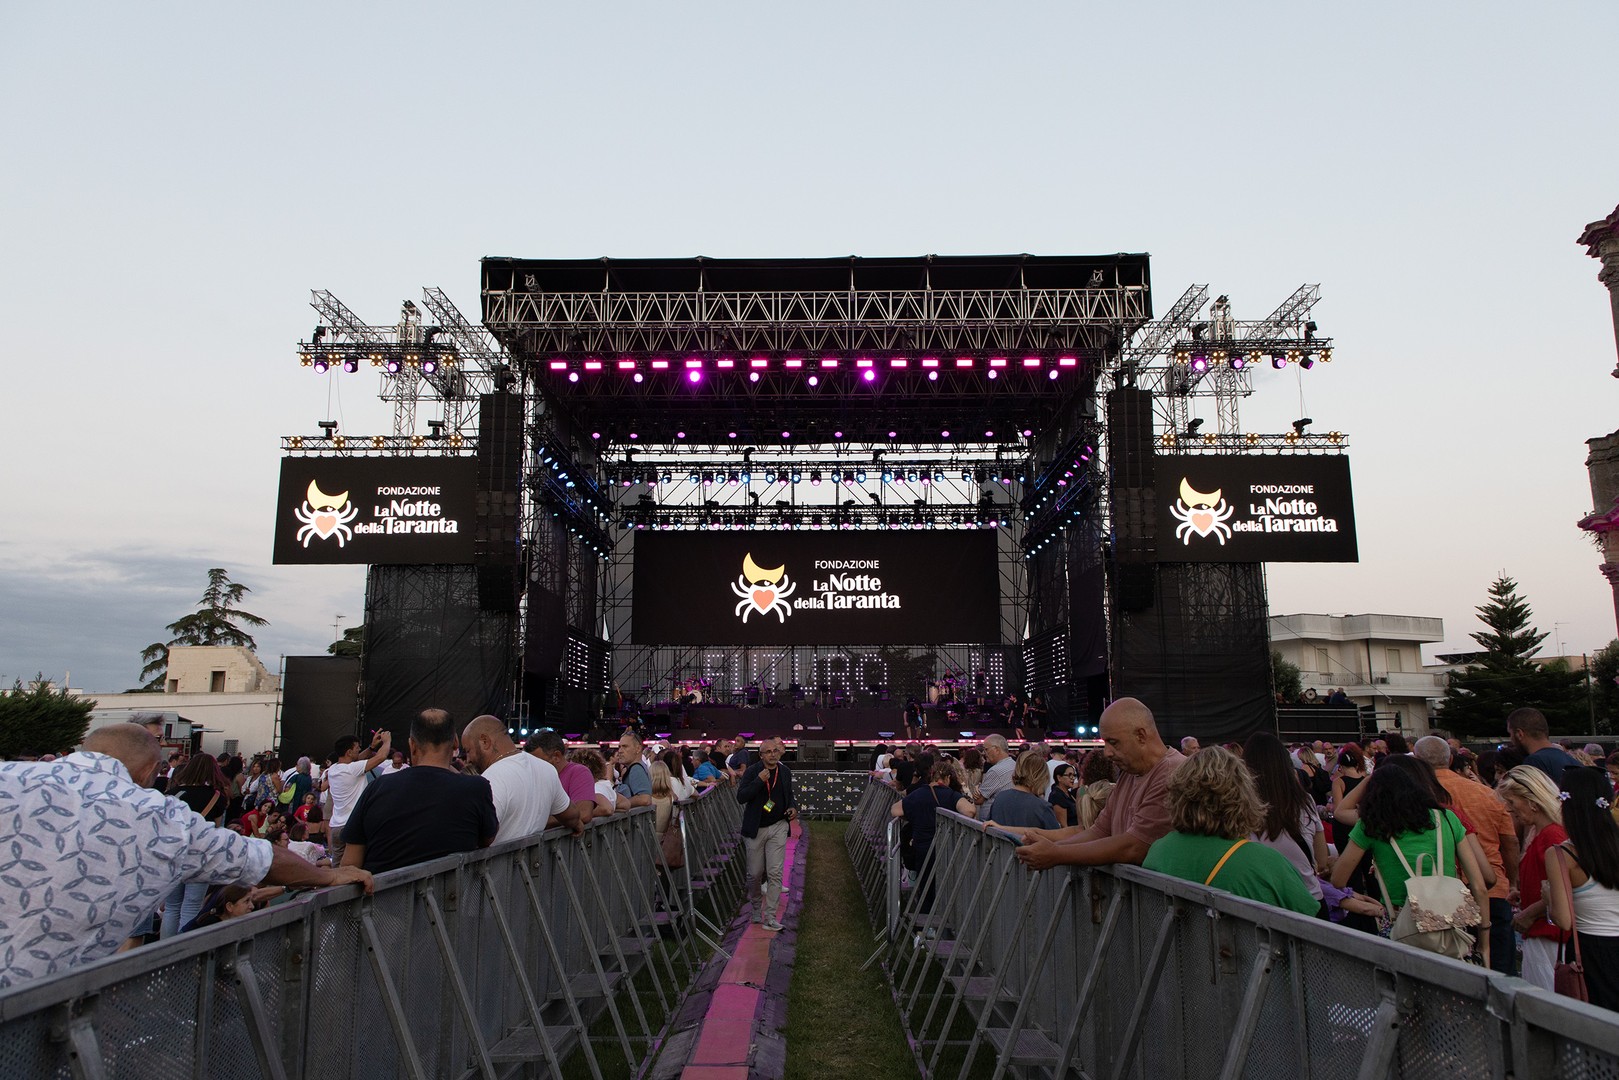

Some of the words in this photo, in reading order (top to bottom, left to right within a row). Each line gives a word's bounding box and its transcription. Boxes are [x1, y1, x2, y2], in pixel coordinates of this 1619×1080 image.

[377, 486, 441, 496] FONDAZIONE
[1249, 484, 1314, 494] FONDAZIONE
[374, 505, 390, 517] La
[390, 498, 442, 517] Notte
[1249, 503, 1266, 516] La
[1265, 496, 1318, 516] Notte
[353, 522, 385, 535] della
[381, 516, 459, 535] Taranta
[1232, 520, 1264, 533] della
[1259, 514, 1339, 533] Taranta
[814, 560, 880, 569] FONDAZIONE
[813, 579, 830, 592] La
[829, 572, 882, 592] Notte
[793, 597, 826, 610] della
[821, 591, 902, 610] Taranta
